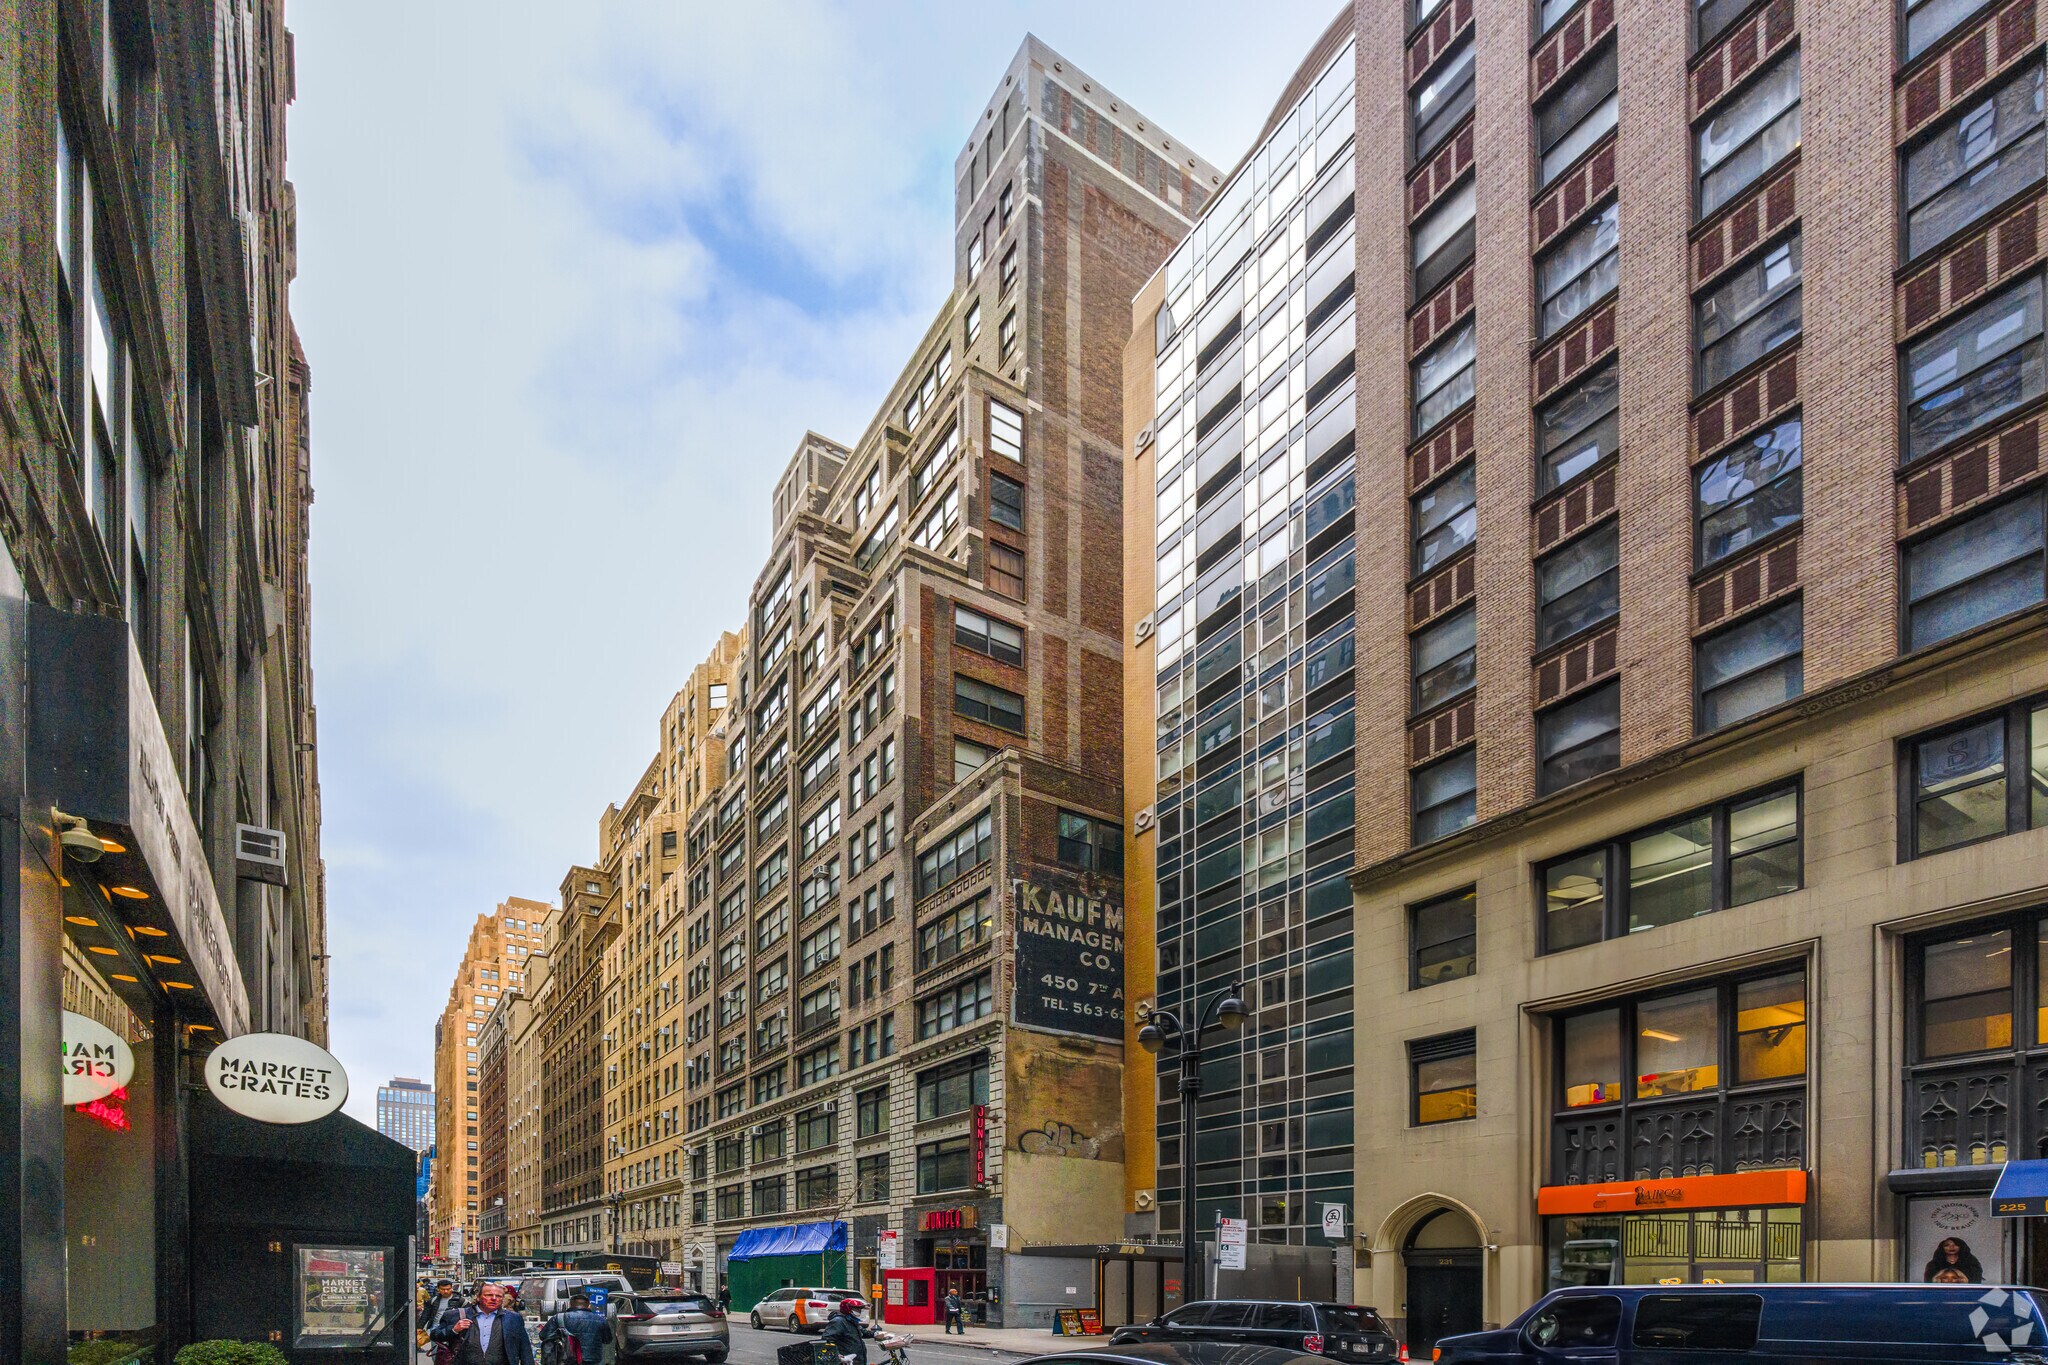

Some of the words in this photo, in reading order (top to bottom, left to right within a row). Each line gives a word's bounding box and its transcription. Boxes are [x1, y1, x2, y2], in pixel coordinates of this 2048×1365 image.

[1022, 881, 1124, 932] KAUFM
[1080, 951, 1116, 972] CO.
[1040, 973, 1079, 992] 450
[1041, 996, 1069, 1011] TEL.
[220, 1056, 332, 1083] MARKET
[219, 1073, 331, 1100] CRATES
[1999, 1203, 2027, 1212] 225
[925, 1209, 961, 1229] JUNIPER
[322, 1279, 366, 1287] MARKET
[323, 1286, 367, 1294] CRATES
[595, 1295, 604, 1304] P
